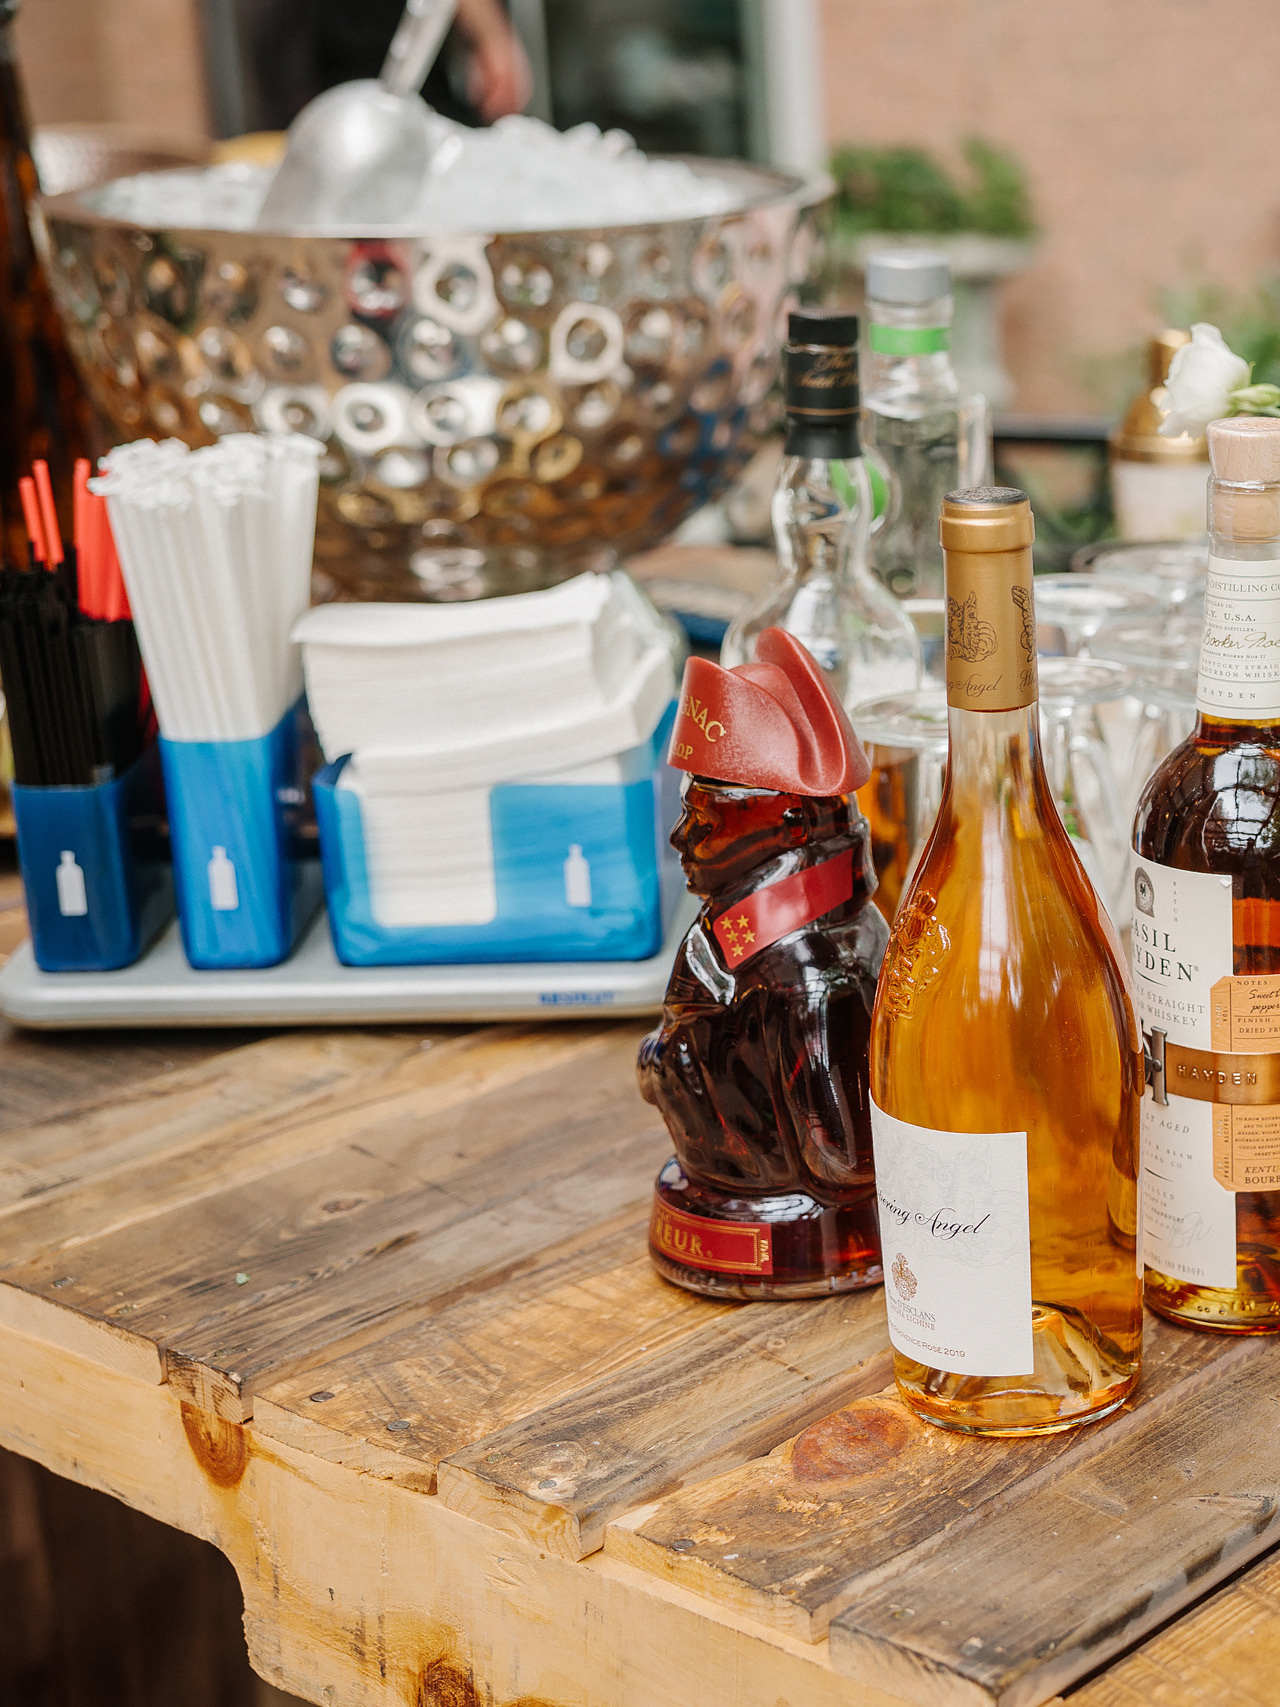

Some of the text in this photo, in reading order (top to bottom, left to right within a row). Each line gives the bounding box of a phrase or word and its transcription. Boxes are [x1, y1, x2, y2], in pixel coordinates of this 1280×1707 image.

[1210, 580, 1268, 592] DISTILLING
[1223, 612, 1256, 621] U.S.A.
[956, 673, 1003, 698] Angel
[1131, 915, 1176, 953] ASIL
[1147, 990, 1205, 1013] STRAIGHT
[1250, 1000, 1280, 1013] pepper
[1147, 1004, 1198, 1027] WHISKEY
[1178, 1064, 1257, 1086] HAYDEN
[1159, 1119, 1190, 1134] AGED
[914, 1207, 991, 1241] Angel
[906, 1314, 936, 1330] LICHINE
[944, 1347, 966, 1358] 2019
